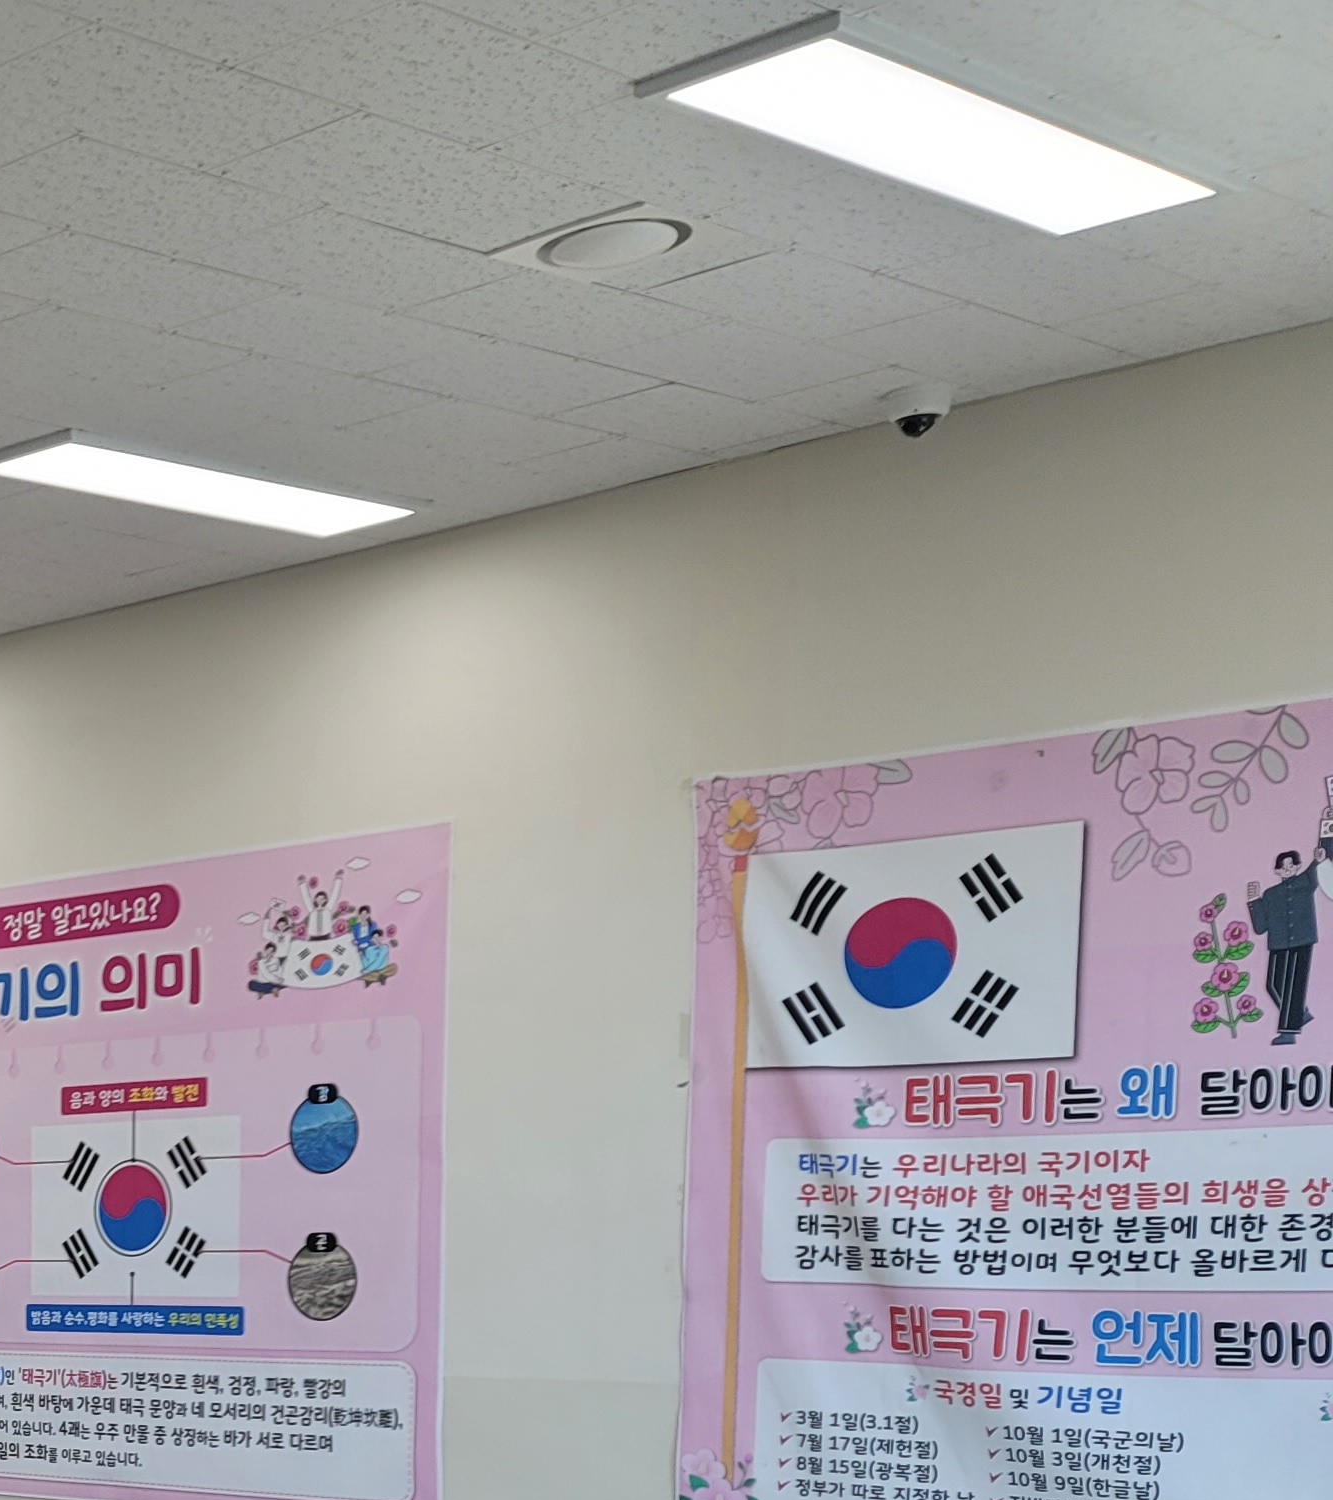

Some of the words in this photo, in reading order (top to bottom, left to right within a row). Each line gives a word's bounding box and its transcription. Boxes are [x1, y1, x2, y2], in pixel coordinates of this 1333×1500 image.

[3, 907, 46, 941] 정말
[50, 892, 161, 936] 알고있나요?
[100, 947, 200, 1012] 의미
[69, 1091, 96, 1110] 음과
[98, 1088, 125, 1107] 양의
[128, 1086, 169, 1103] 조화와
[904, 1069, 1103, 1125] 태극기는
[1116, 1063, 1175, 1117] 왜
[799, 1153, 882, 1179] 태극기는
[893, 1152, 1027, 1178] 우리나라의
[1037, 1149, 1150, 1178] 국기이자
[797, 1183, 858, 1207] 우리가
[866, 1184, 978, 1210] 기억해야
[987, 1184, 1014, 1212] 할
[1022, 1181, 1189, 1211] 애국선열들의
[1202, 1177, 1290, 1209] 희생을
[315, 1234, 328, 1250] 곤
[797, 1214, 881, 1242] 태극기를
[893, 1216, 945, 1243] 다는
[956, 1217, 1011, 1244] 것은
[1023, 1216, 1104, 1244] 이러한
[1114, 1215, 1198, 1244] 분들에
[1211, 1213, 1269, 1243] 대한
[795, 1245, 864, 1272] 감사를
[870, 1247, 941, 1274] 표하는
[953, 1249, 1057, 1276] 방법이며
[1068, 1250, 1180, 1277] 무엇보다
[1190, 1248, 1307, 1278] 올바르게
[121, 1312, 165, 1327] 사랑하는
[167, 1312, 202, 1326] 우리의
[204, 1313, 239, 1329] 민족성
[889, 1305, 1074, 1363] 태극기는
[1092, 1310, 1199, 1367] 언제
[121, 1372, 188, 1391] 기본적으로
[192, 1374, 224, 1395] 흰색,
[228, 1375, 261, 1397] 검정,
[265, 1377, 299, 1399] 파랑,
[303, 1378, 346, 1400] 빨강의
[933, 1380, 1003, 1410] 국경일
[1009, 1388, 1030, 1411] 및
[1036, 1386, 1123, 1415] 기념일
[11, 1392, 34, 1412] 흰색
[39, 1394, 74, 1414] 바탕에
[77, 1396, 115, 1416] 가운데
[120, 1398, 145, 1418] 태극
[149, 1399, 187, 1420] 문양과
[191, 1401, 205, 1419] 네
[209, 1402, 266, 1421] 모서리의
[11, 1419, 56, 1437] 있습니다.
[59, 1421, 91, 1440] 4괘는
[94, 1423, 119, 1441] 우주
[123, 1424, 150, 1444] 만물
[153, 1426, 167, 1446] 중
[171, 1427, 220, 1448] 상징하는
[224, 1430, 252, 1448] 바가
[256, 1431, 285, 1449] 서로
[289, 1433, 333, 1452] 다르며
[796, 1410, 823, 1430] 3월
[829, 1412, 919, 1436] 1일(3.1절)
[796, 1433, 823, 1452] 7월
[829, 1436, 939, 1461] 17일(제헌절)
[1003, 1425, 1044, 1446] 10월
[1051, 1427, 1185, 1453] 1일(국군의날)
[24, 1444, 59, 1464] 조화를
[61, 1448, 92, 1464] 이루고
[95, 1450, 143, 1468] 있습니다.
[796, 1456, 823, 1475] 8월
[829, 1458, 939, 1484] 15일(광복절)
[1005, 1447, 1045, 1469] 10월
[1052, 1452, 1161, 1476] 3일(개천절)
[795, 1478, 845, 1498] 정부가
[851, 1484, 886, 1500] 따로
[1007, 1471, 1048, 1492] 10월
[1054, 1475, 1160, 1500] 9일(한글날)
